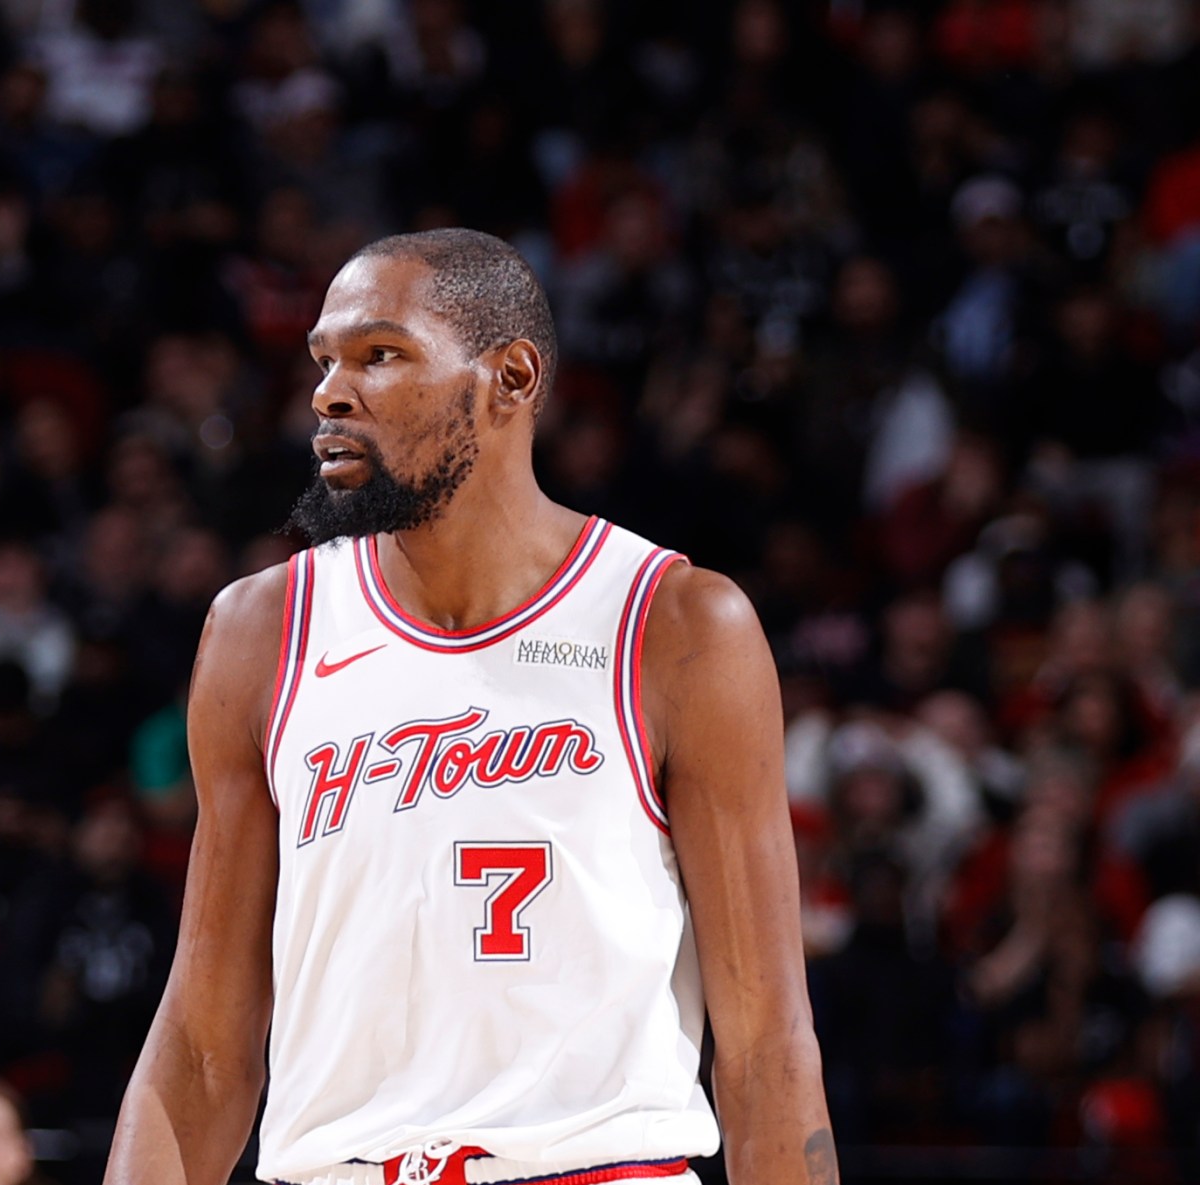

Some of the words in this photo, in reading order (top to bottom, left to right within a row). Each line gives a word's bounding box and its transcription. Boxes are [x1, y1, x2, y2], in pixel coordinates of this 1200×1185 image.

[517, 650, 607, 669] HERMANN
[518, 639, 607, 659] MEMORIAL
[297, 706, 605, 849] H-Town
[453, 841, 553, 962] 7
